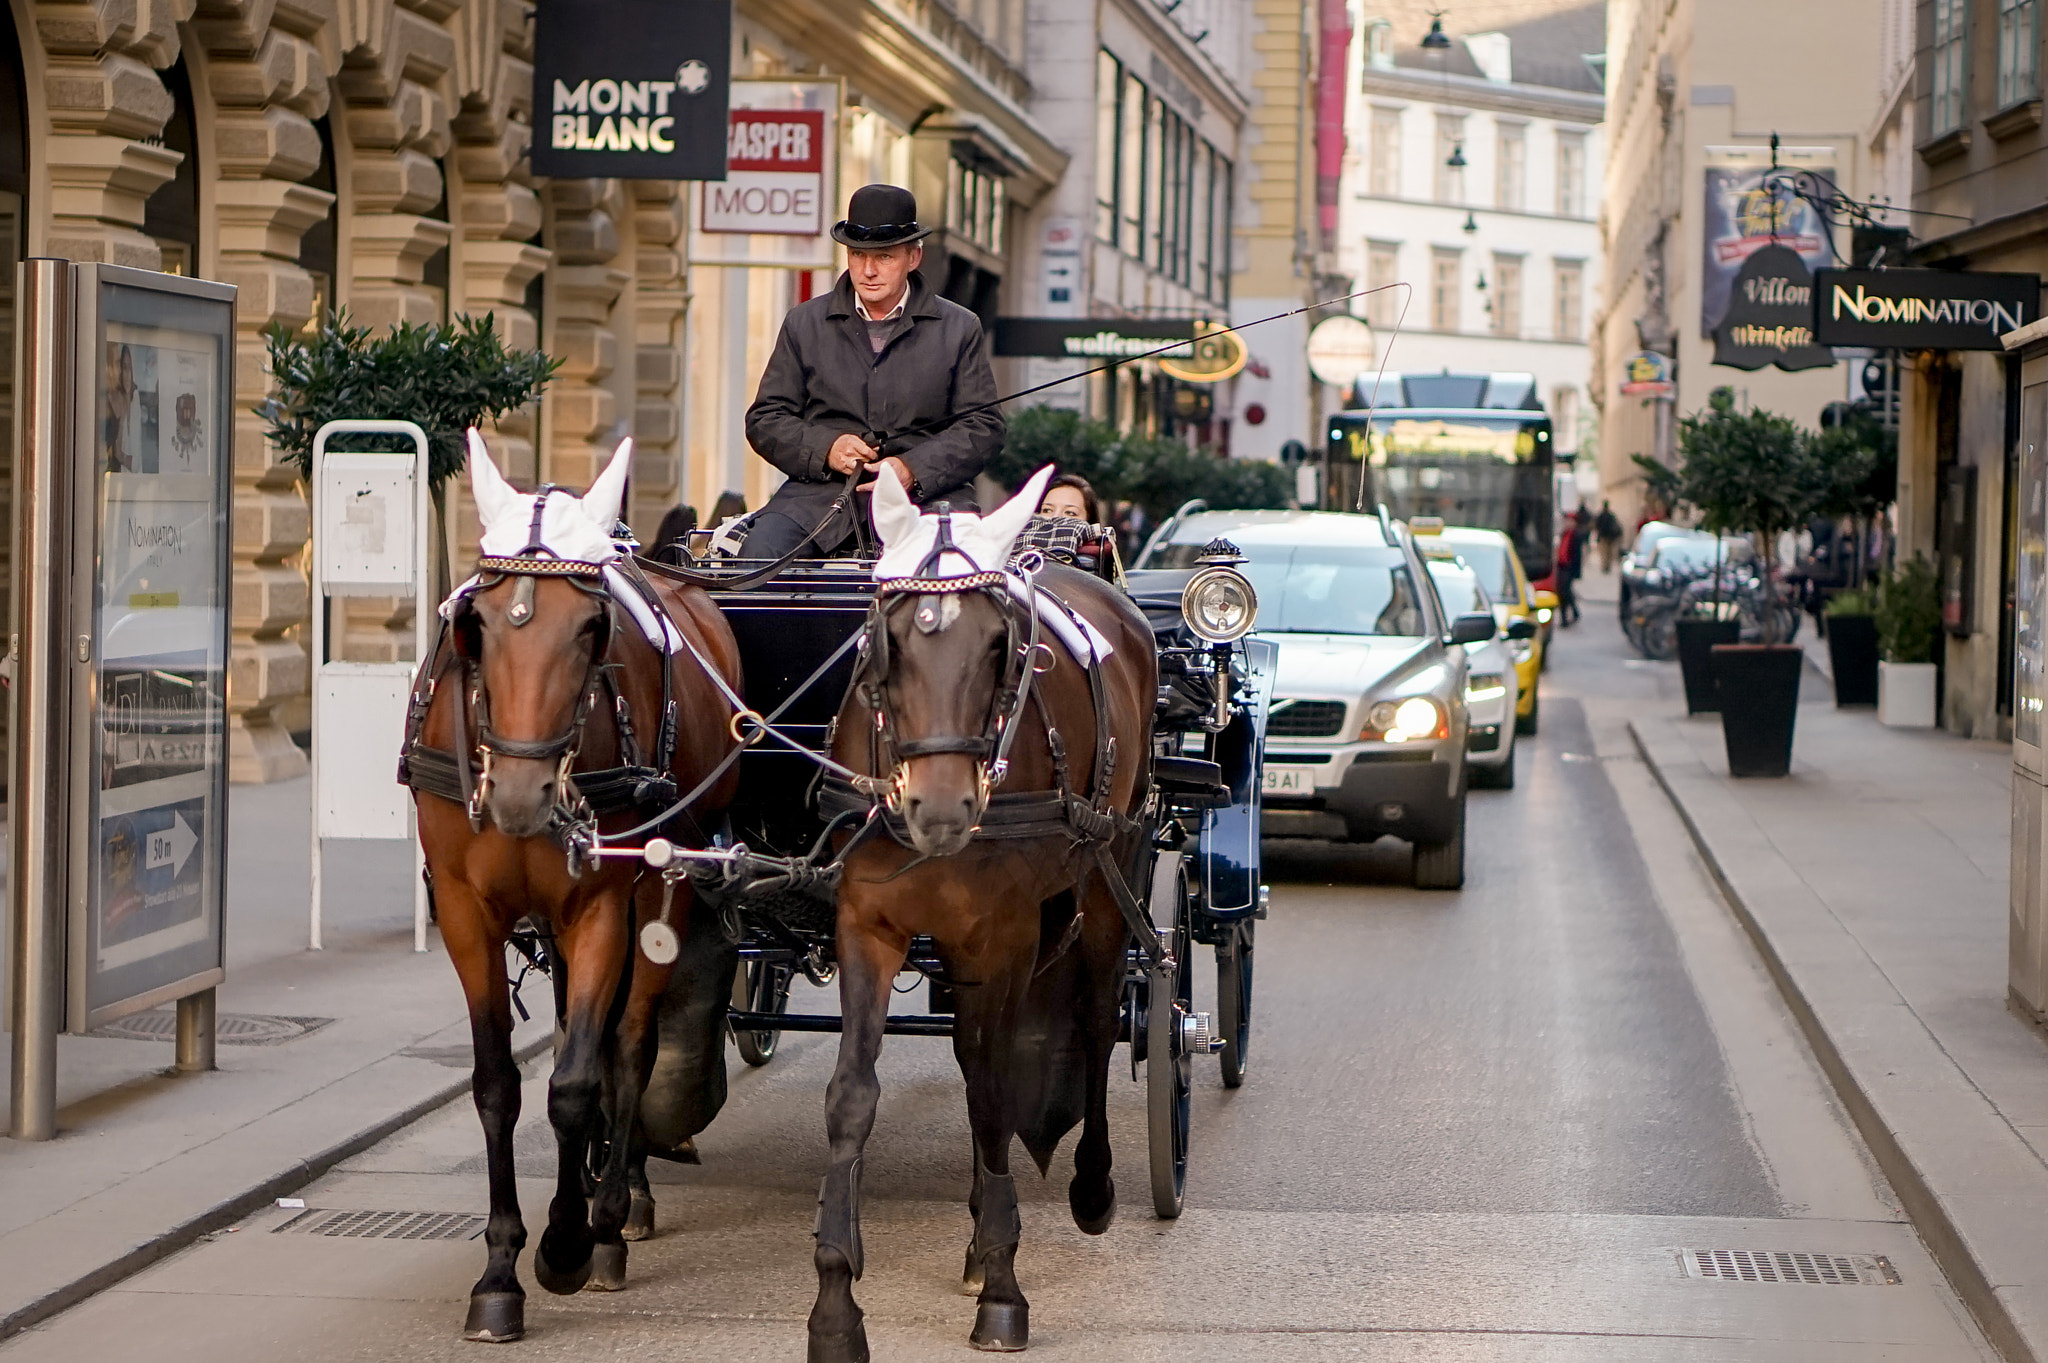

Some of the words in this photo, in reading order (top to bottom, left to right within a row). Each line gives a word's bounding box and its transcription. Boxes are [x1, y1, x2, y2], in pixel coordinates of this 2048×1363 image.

[553, 78, 676, 115] MONT
[552, 114, 675, 153] BLANC
[714, 187, 812, 215] MODE
[1743, 276, 1811, 305] Villon
[1832, 284, 2024, 337] NOMINATION
[1729, 323, 1814, 353] Weinkelle
[153, 837, 163, 861] 50
[164, 840, 172, 858] m
